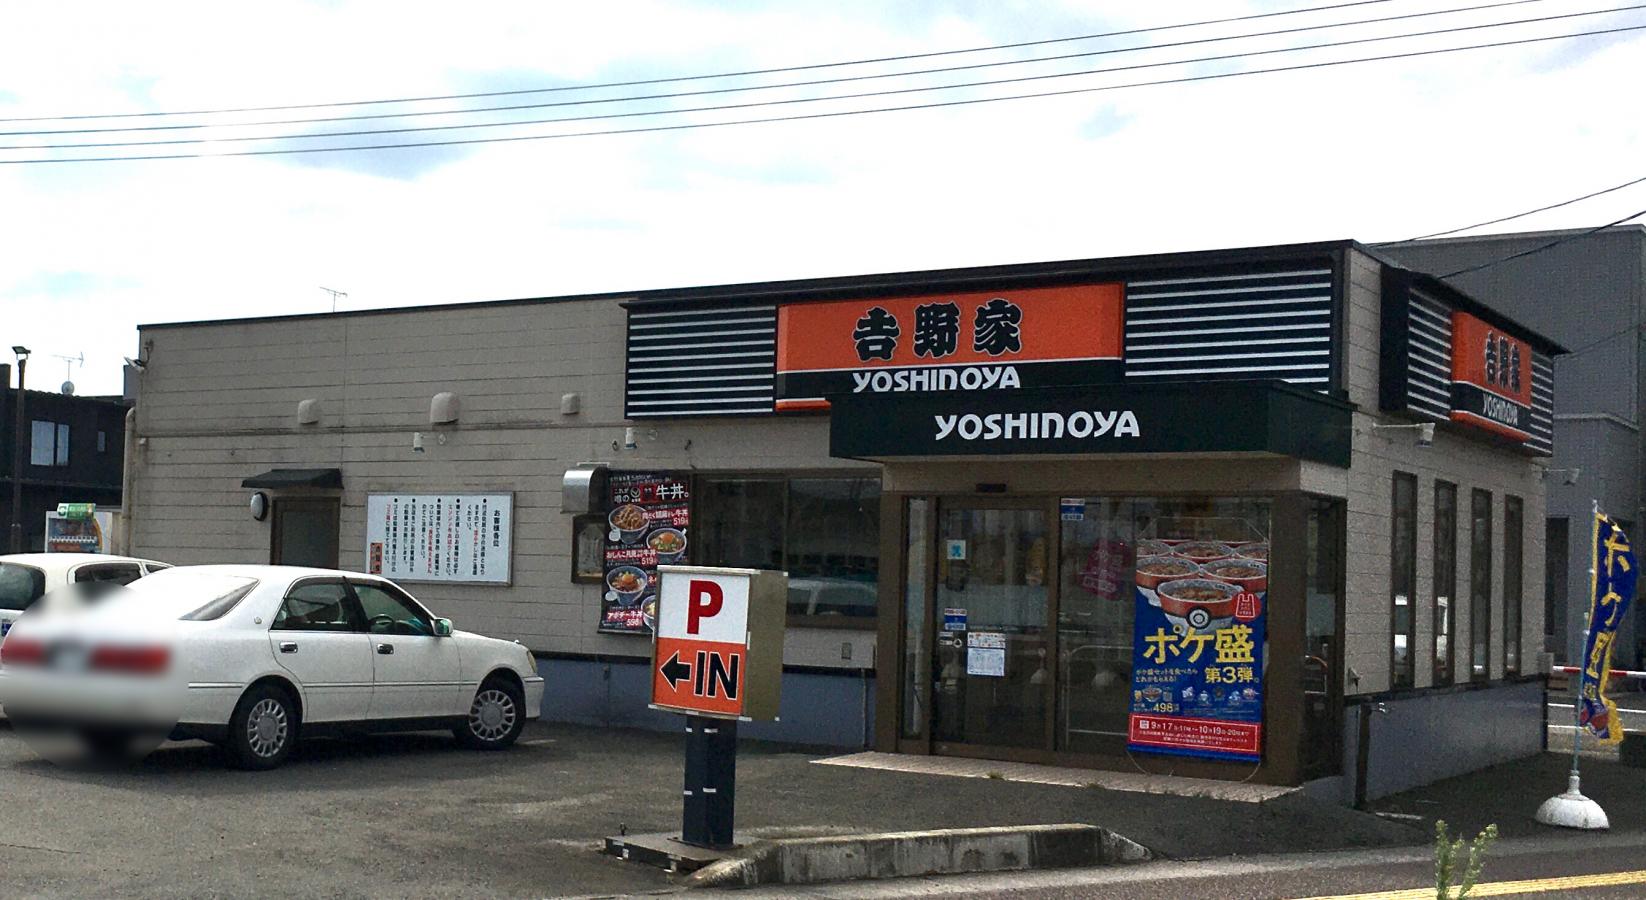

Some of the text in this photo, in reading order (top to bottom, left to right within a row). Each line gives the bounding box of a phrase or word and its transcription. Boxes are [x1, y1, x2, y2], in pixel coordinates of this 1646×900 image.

[853, 366, 1021, 394] YOSHINOYA
[934, 410, 1141, 441] YOSHINOYA
[493, 509, 501, 548] お客様各位
[687, 579, 724, 635] P
[1143, 624, 1255, 664] ポケ盛
[694, 650, 740, 701] IN
